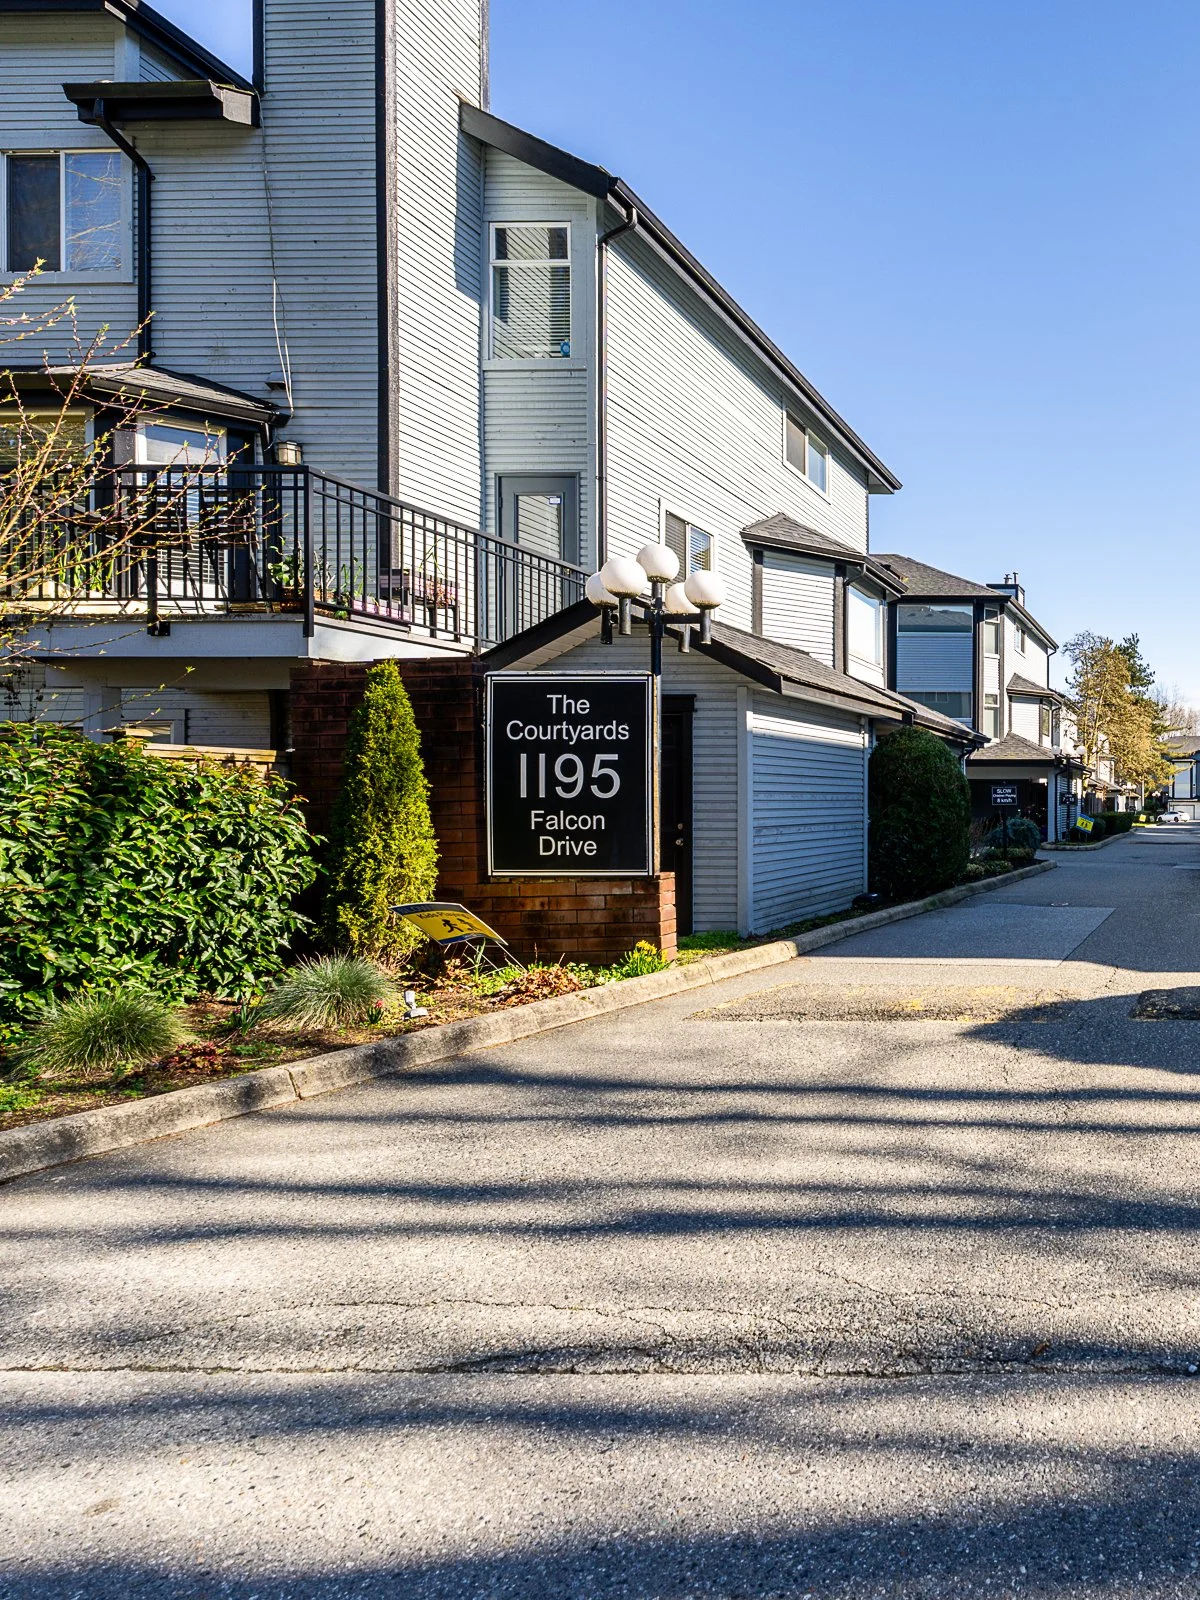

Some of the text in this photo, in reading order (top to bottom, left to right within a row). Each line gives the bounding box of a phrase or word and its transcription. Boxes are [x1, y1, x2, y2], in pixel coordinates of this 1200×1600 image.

[546, 694, 590, 714] The
[506, 720, 630, 745] Courtyards
[519, 753, 621, 799] 1195
[530, 810, 606, 830] Falcon
[539, 836, 597, 856] Drive
